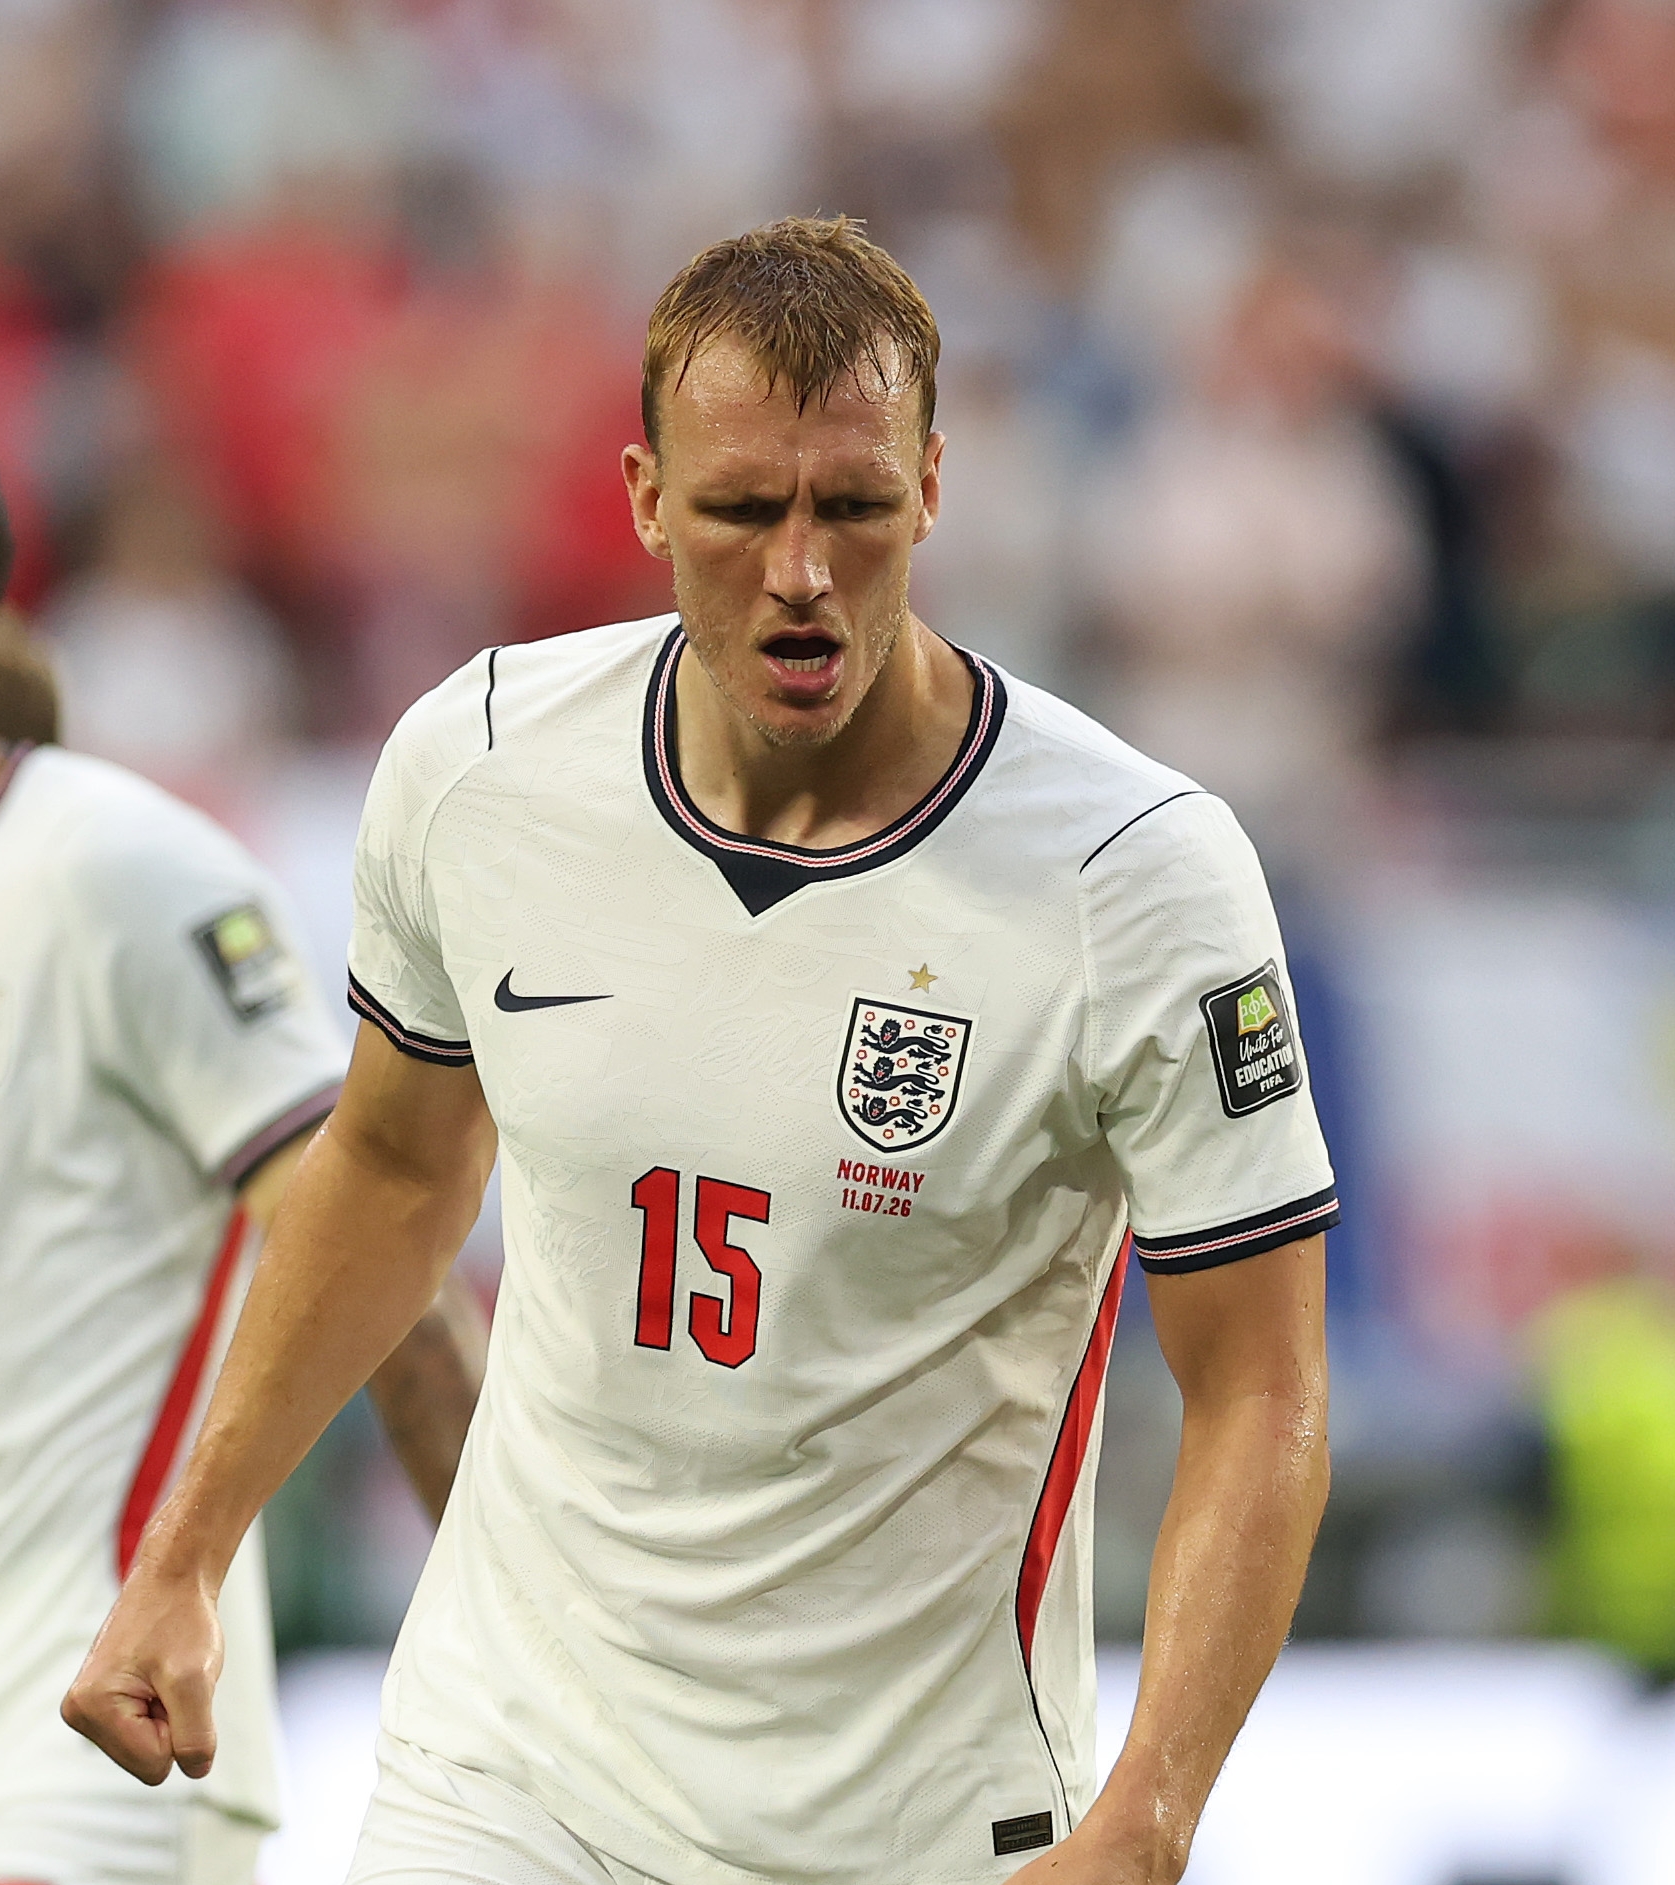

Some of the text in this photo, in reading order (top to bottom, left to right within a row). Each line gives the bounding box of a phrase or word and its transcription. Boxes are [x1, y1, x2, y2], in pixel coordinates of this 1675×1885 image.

[1239, 1022, 1284, 1061] Unite For
[1234, 1042, 1295, 1087] EDUCATION
[1260, 1073, 1284, 1093] FIFA
[836, 1158, 925, 1193] NORWAY
[841, 1188, 912, 1217] 11.07.26
[631, 1166, 772, 1369] 15
